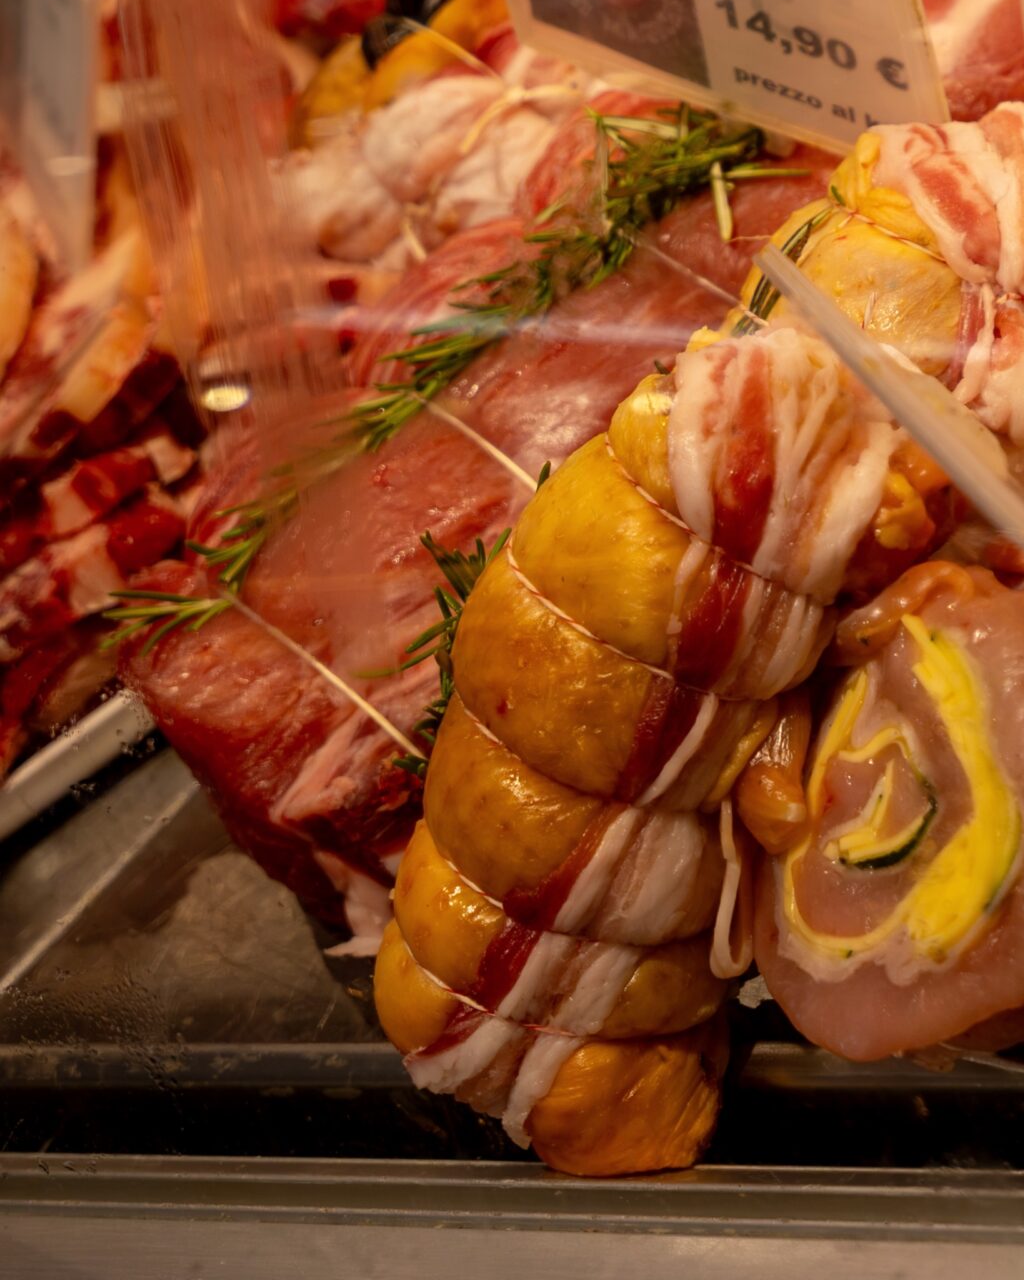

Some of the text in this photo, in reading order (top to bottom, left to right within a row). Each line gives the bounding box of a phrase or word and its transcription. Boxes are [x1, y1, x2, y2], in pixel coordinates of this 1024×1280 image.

[733, 67, 823, 111] prezzo
[832, 103, 856, 124] al
[876, 57, 909, 92] €
